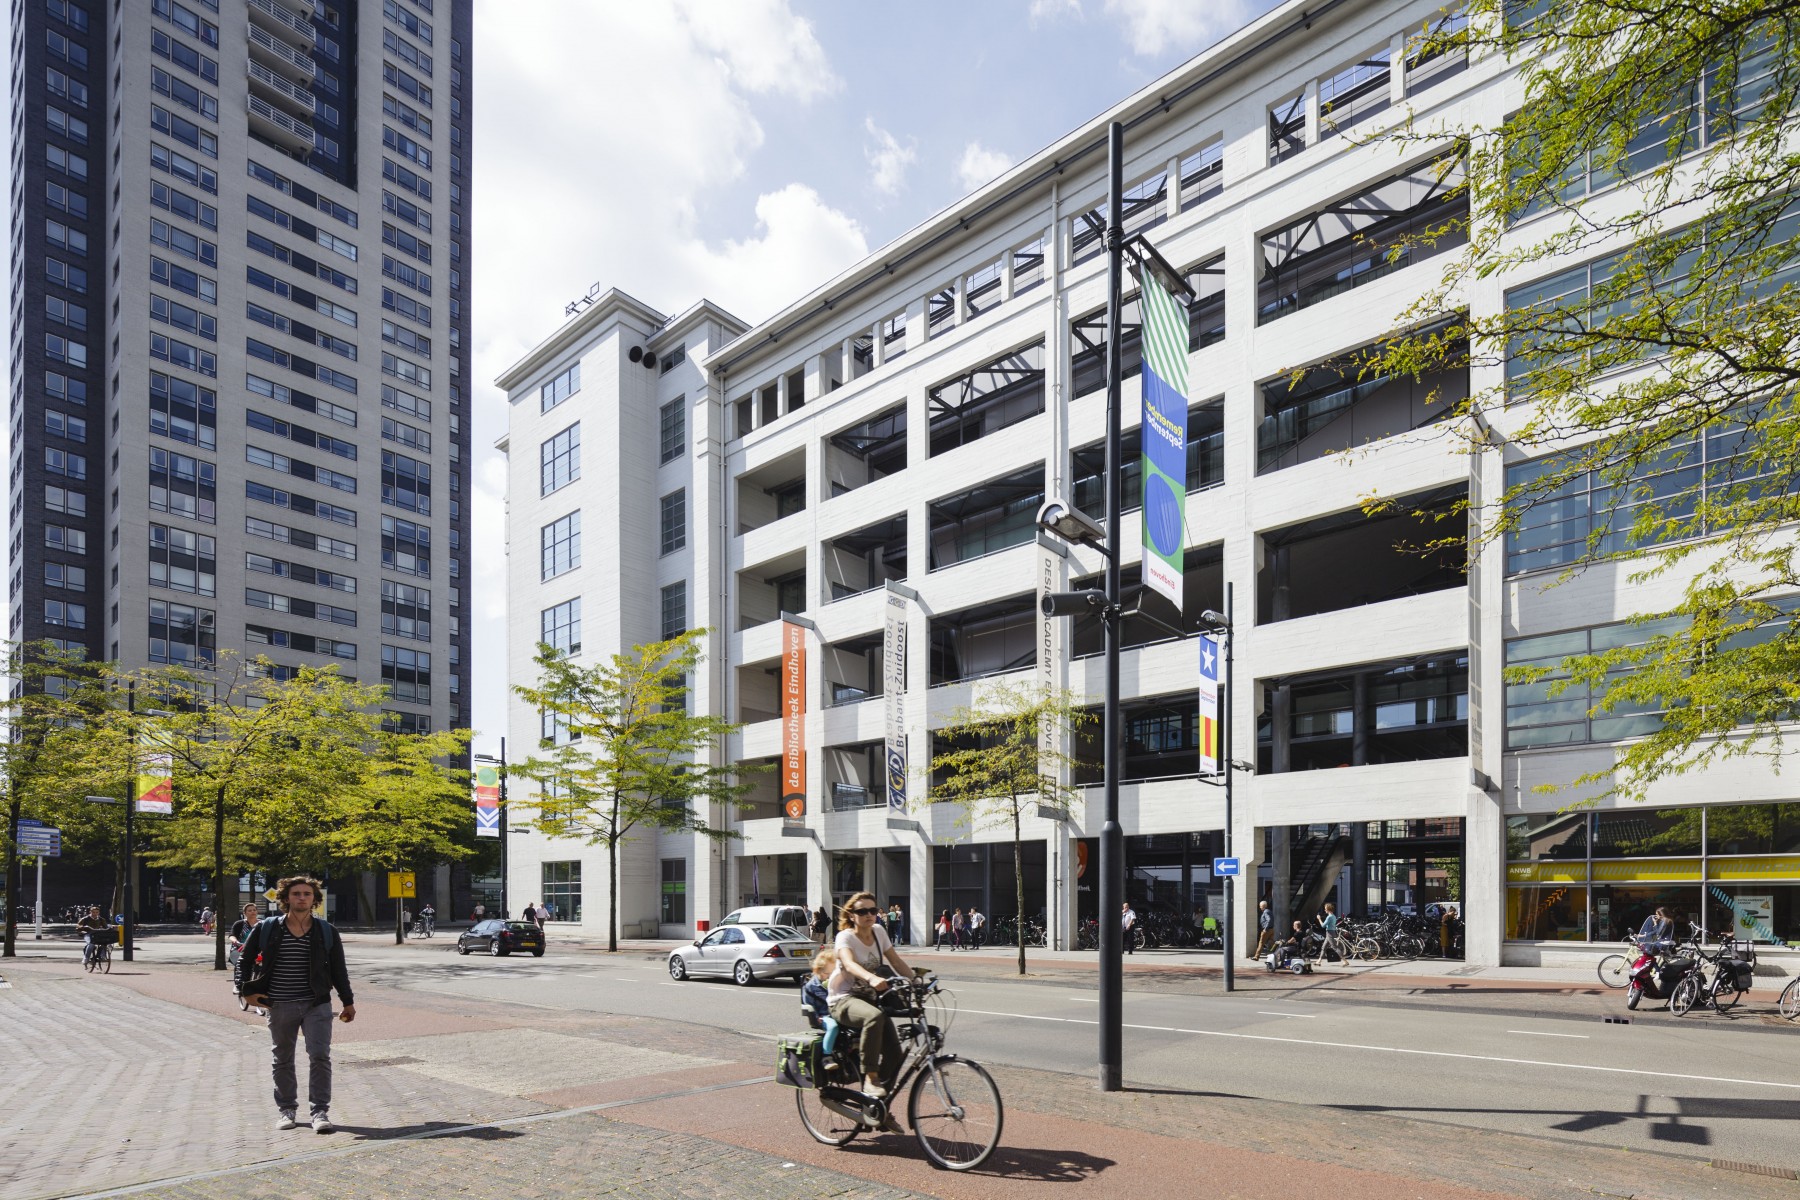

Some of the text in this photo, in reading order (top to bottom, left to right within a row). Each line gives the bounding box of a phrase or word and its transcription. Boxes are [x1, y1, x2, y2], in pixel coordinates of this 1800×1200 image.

[788, 627, 799, 788] de Bibliotheek Eindhoven
[895, 620, 905, 748] Brabant-Zuidoost
